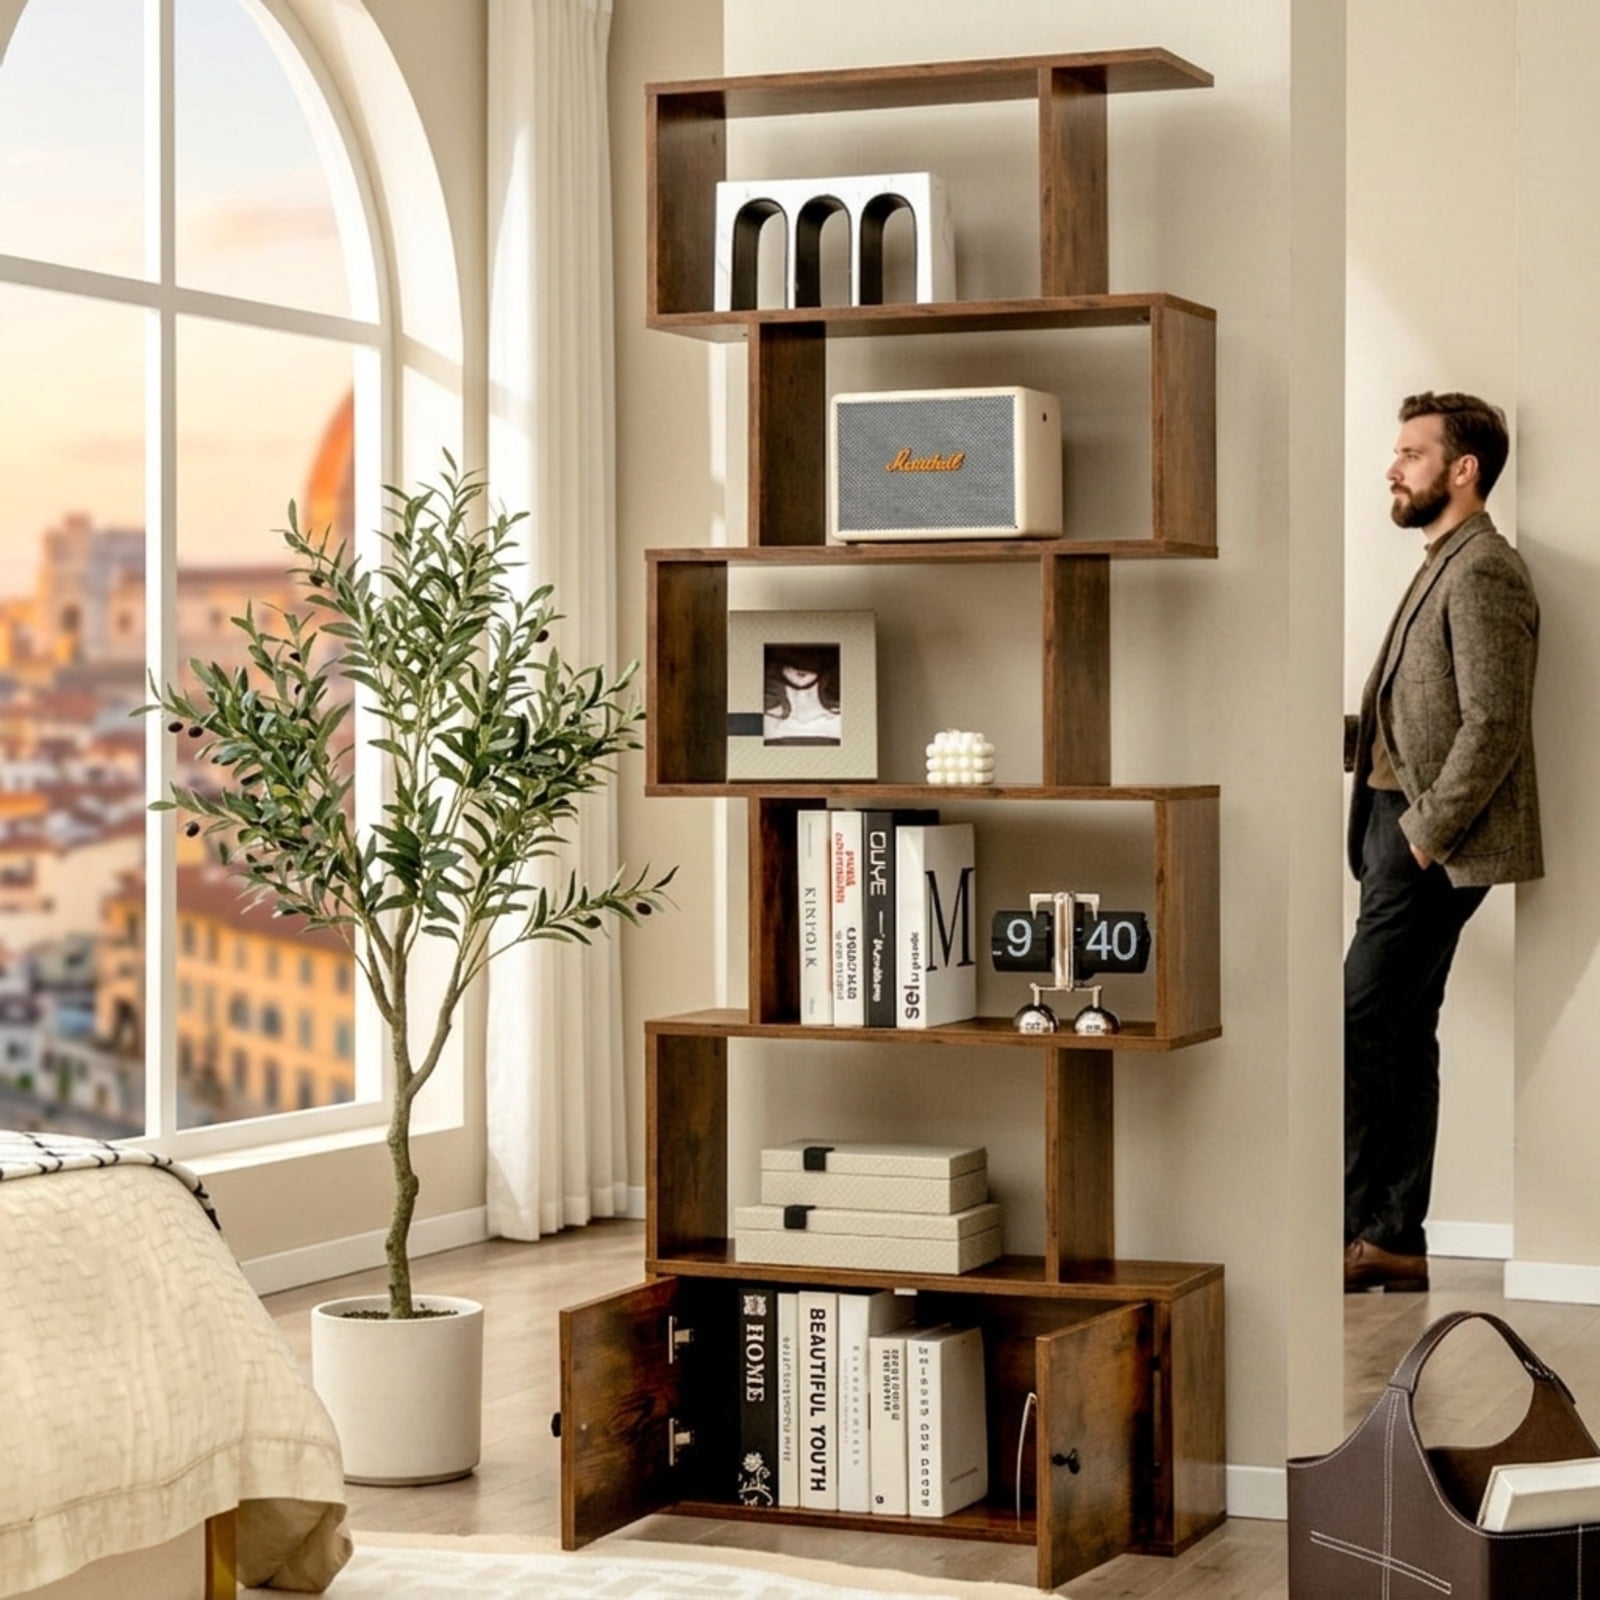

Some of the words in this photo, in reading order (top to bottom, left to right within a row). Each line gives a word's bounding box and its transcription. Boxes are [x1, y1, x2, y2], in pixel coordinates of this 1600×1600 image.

[925, 867, 976, 972] M
[1007, 918, 1032, 957] 9
[1086, 921, 1137, 960] 40
[746, 1324, 765, 1402] HOME
[810, 1308, 826, 1417] BEAUTIFUL
[810, 1425, 826, 1492] YOUTH
